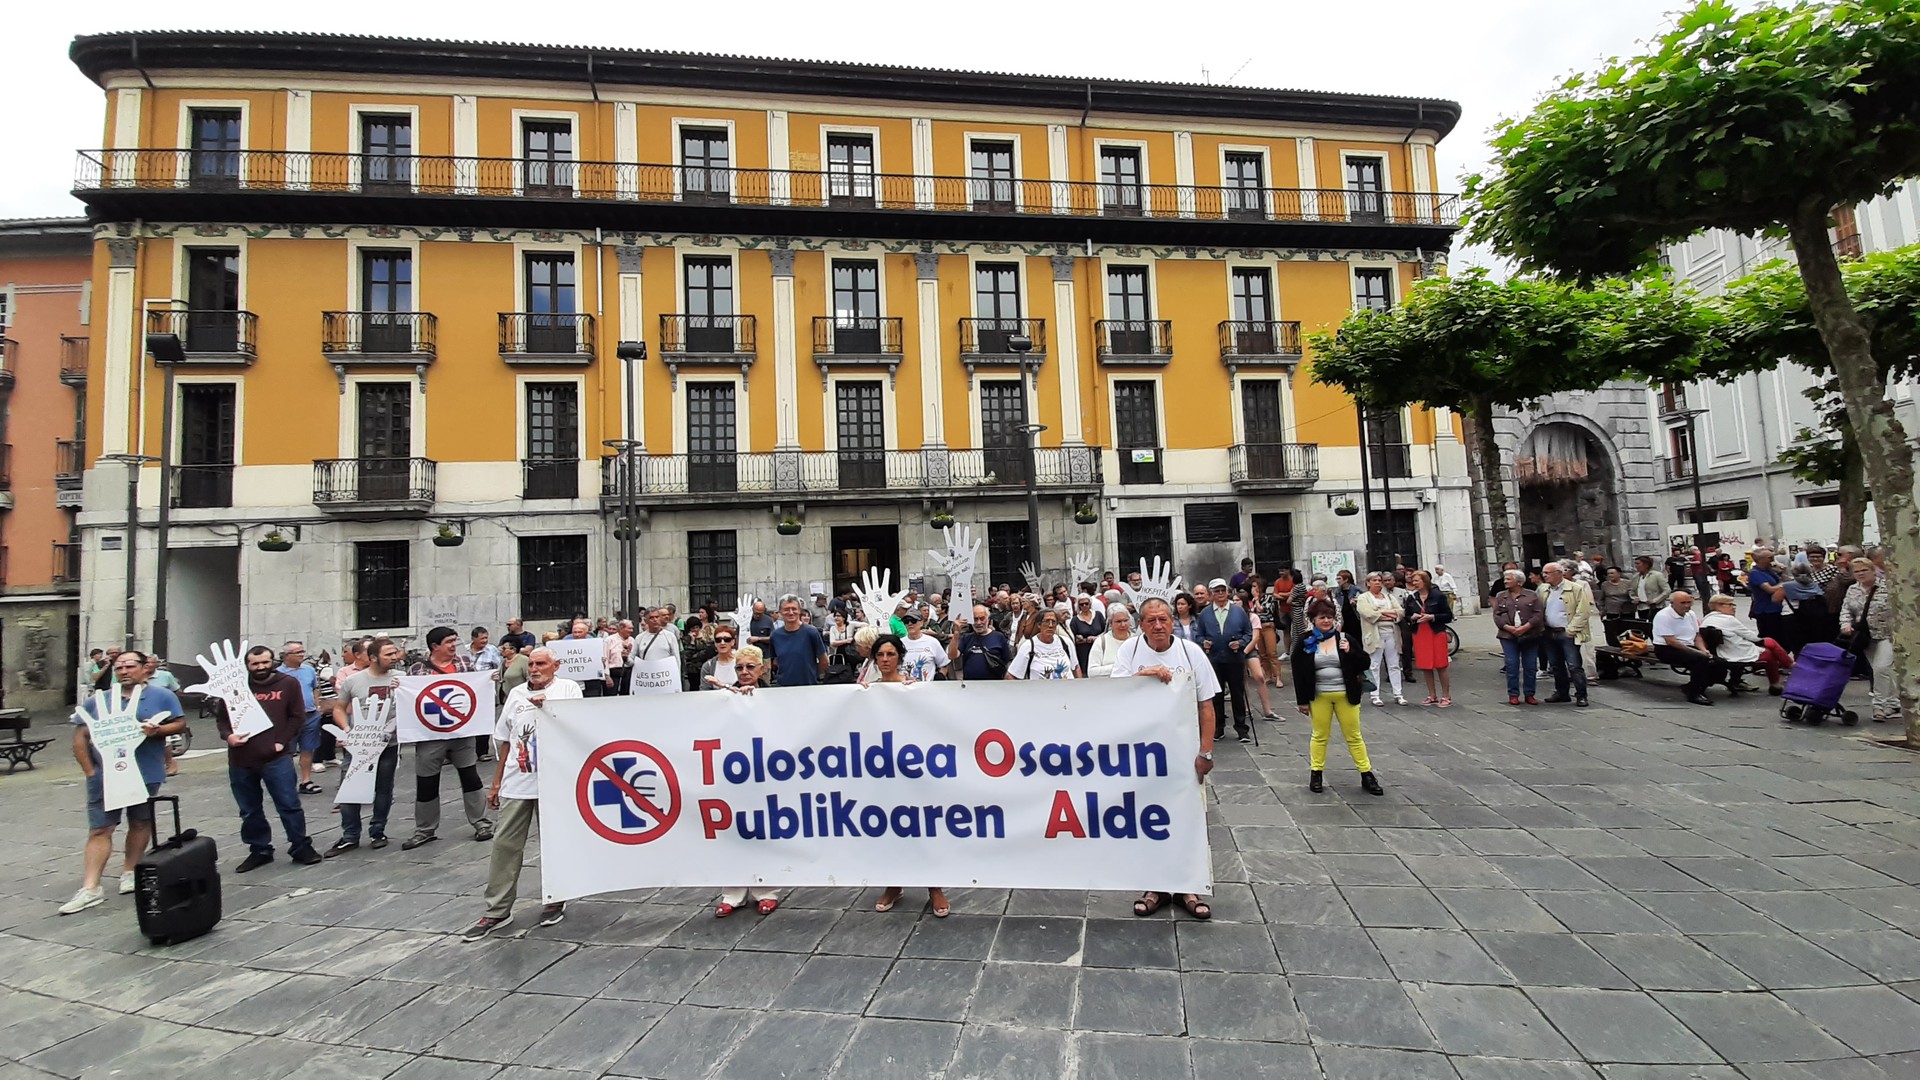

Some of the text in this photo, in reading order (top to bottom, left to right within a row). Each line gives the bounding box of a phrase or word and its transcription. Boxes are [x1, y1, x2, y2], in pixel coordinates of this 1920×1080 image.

[1141, 586, 1169, 598] HOSPITAL
[567, 648, 583, 656] HAU
[559, 656, 593, 665] EKITATEA
[210, 659, 243, 681] OSPITALE
[568, 665, 585, 673] OTE?
[651, 670, 670, 679] ESTO
[208, 668, 244, 691] PUBLIKOA
[635, 678, 673, 688] EQUIDAD??
[93, 714, 134, 729] OSASUN
[347, 732, 382, 740] PUBLIKOA
[693, 728, 1168, 785] Tolosaldea Osasun
[698, 790, 1170, 840] Publikoaren Alde
